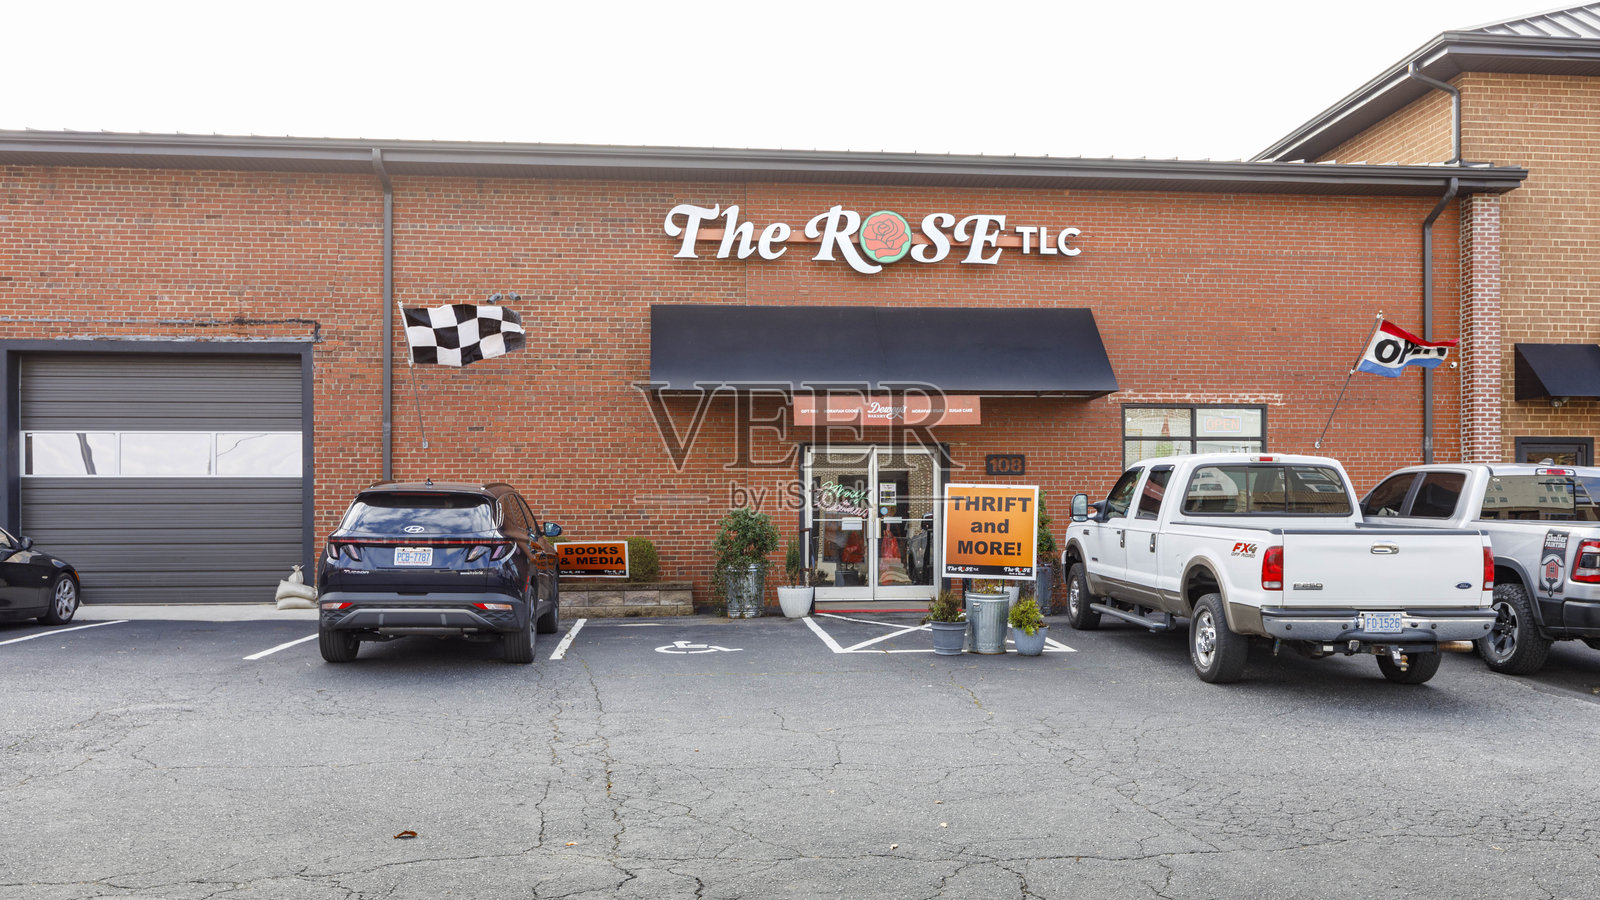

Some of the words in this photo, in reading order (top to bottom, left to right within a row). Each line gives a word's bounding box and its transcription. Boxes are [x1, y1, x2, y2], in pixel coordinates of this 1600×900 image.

[664, 203, 791, 260] The
[1015, 226, 1083, 257] TLC
[1206, 418, 1239, 431] OPEN
[989, 457, 1023, 473] 108
[951, 495, 1032, 513] THRIFT
[970, 519, 1010, 534] and
[564, 546, 619, 555] BOOKS
[957, 540, 1022, 556] MORE!
[1232, 542, 1258, 554] FX4
[560, 557, 571, 565] &
[576, 556, 625, 565] MEDIA
